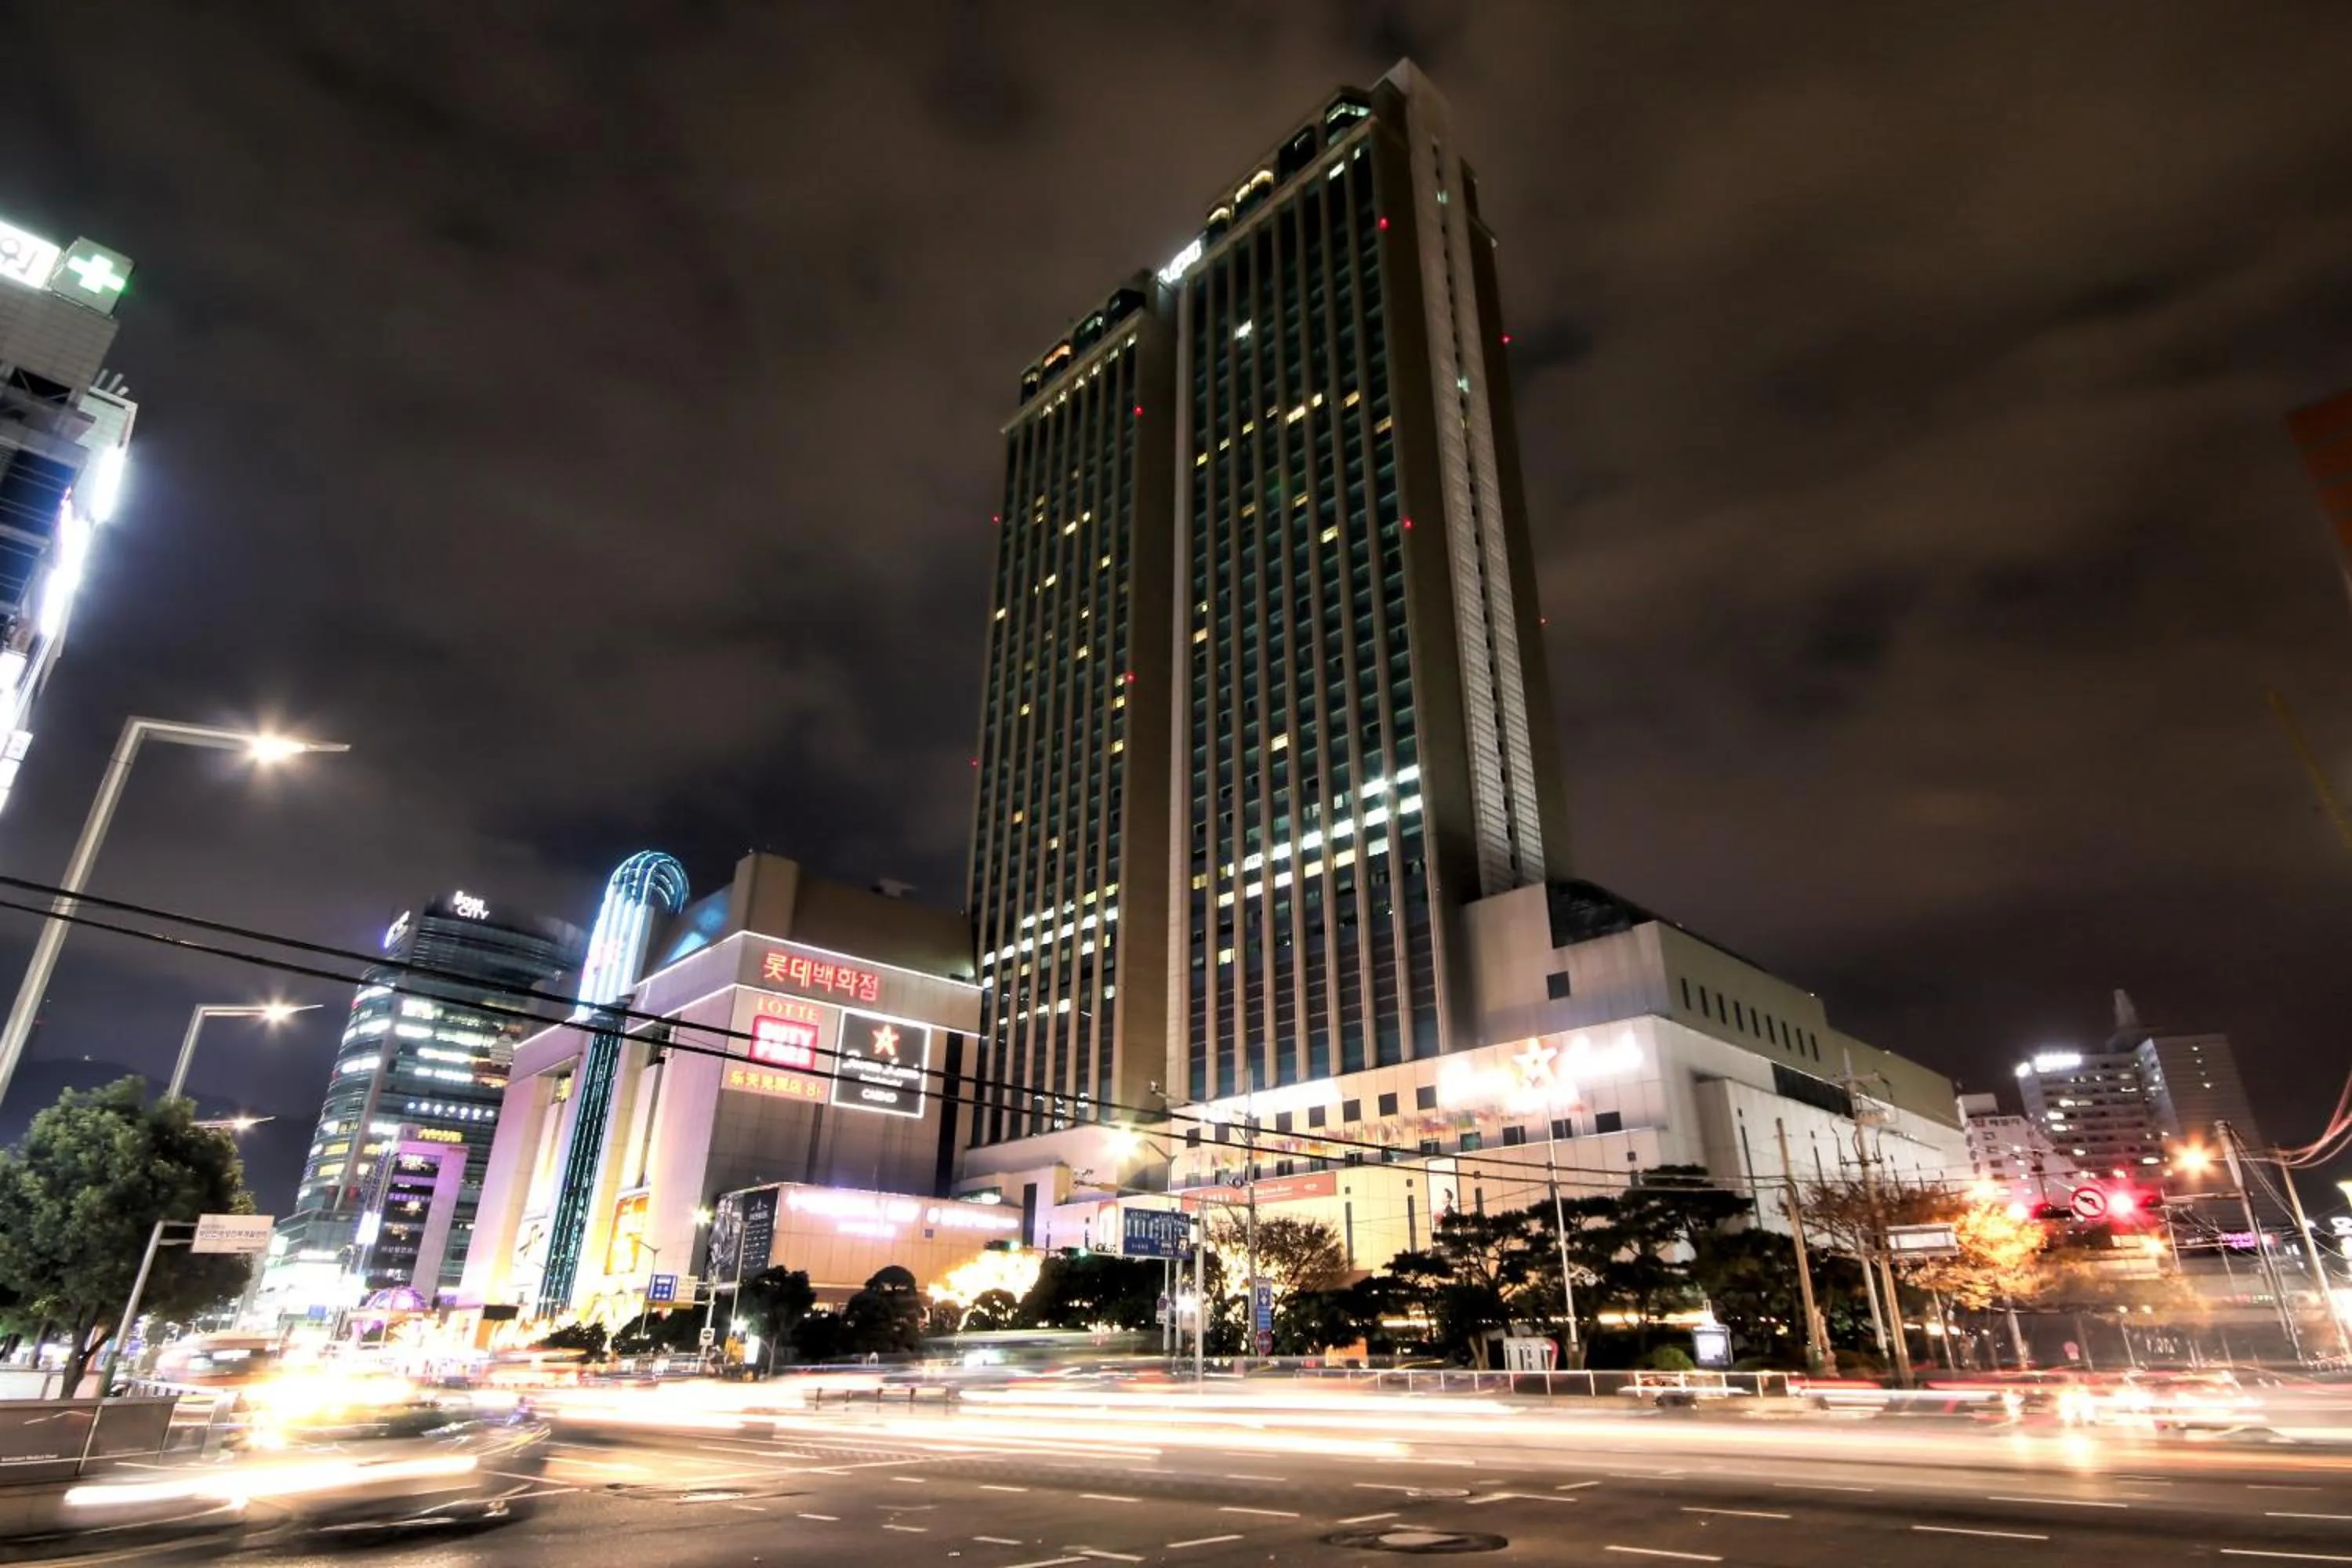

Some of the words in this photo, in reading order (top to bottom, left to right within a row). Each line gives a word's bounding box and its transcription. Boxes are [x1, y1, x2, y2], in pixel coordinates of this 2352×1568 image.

[457, 906, 490, 920] CITY
[764, 952, 880, 1002] 롯데백화점
[756, 996, 818, 1022] LOTTE
[758, 1021, 815, 1047] DUTY
[861, 1087, 898, 1103] CASINO
